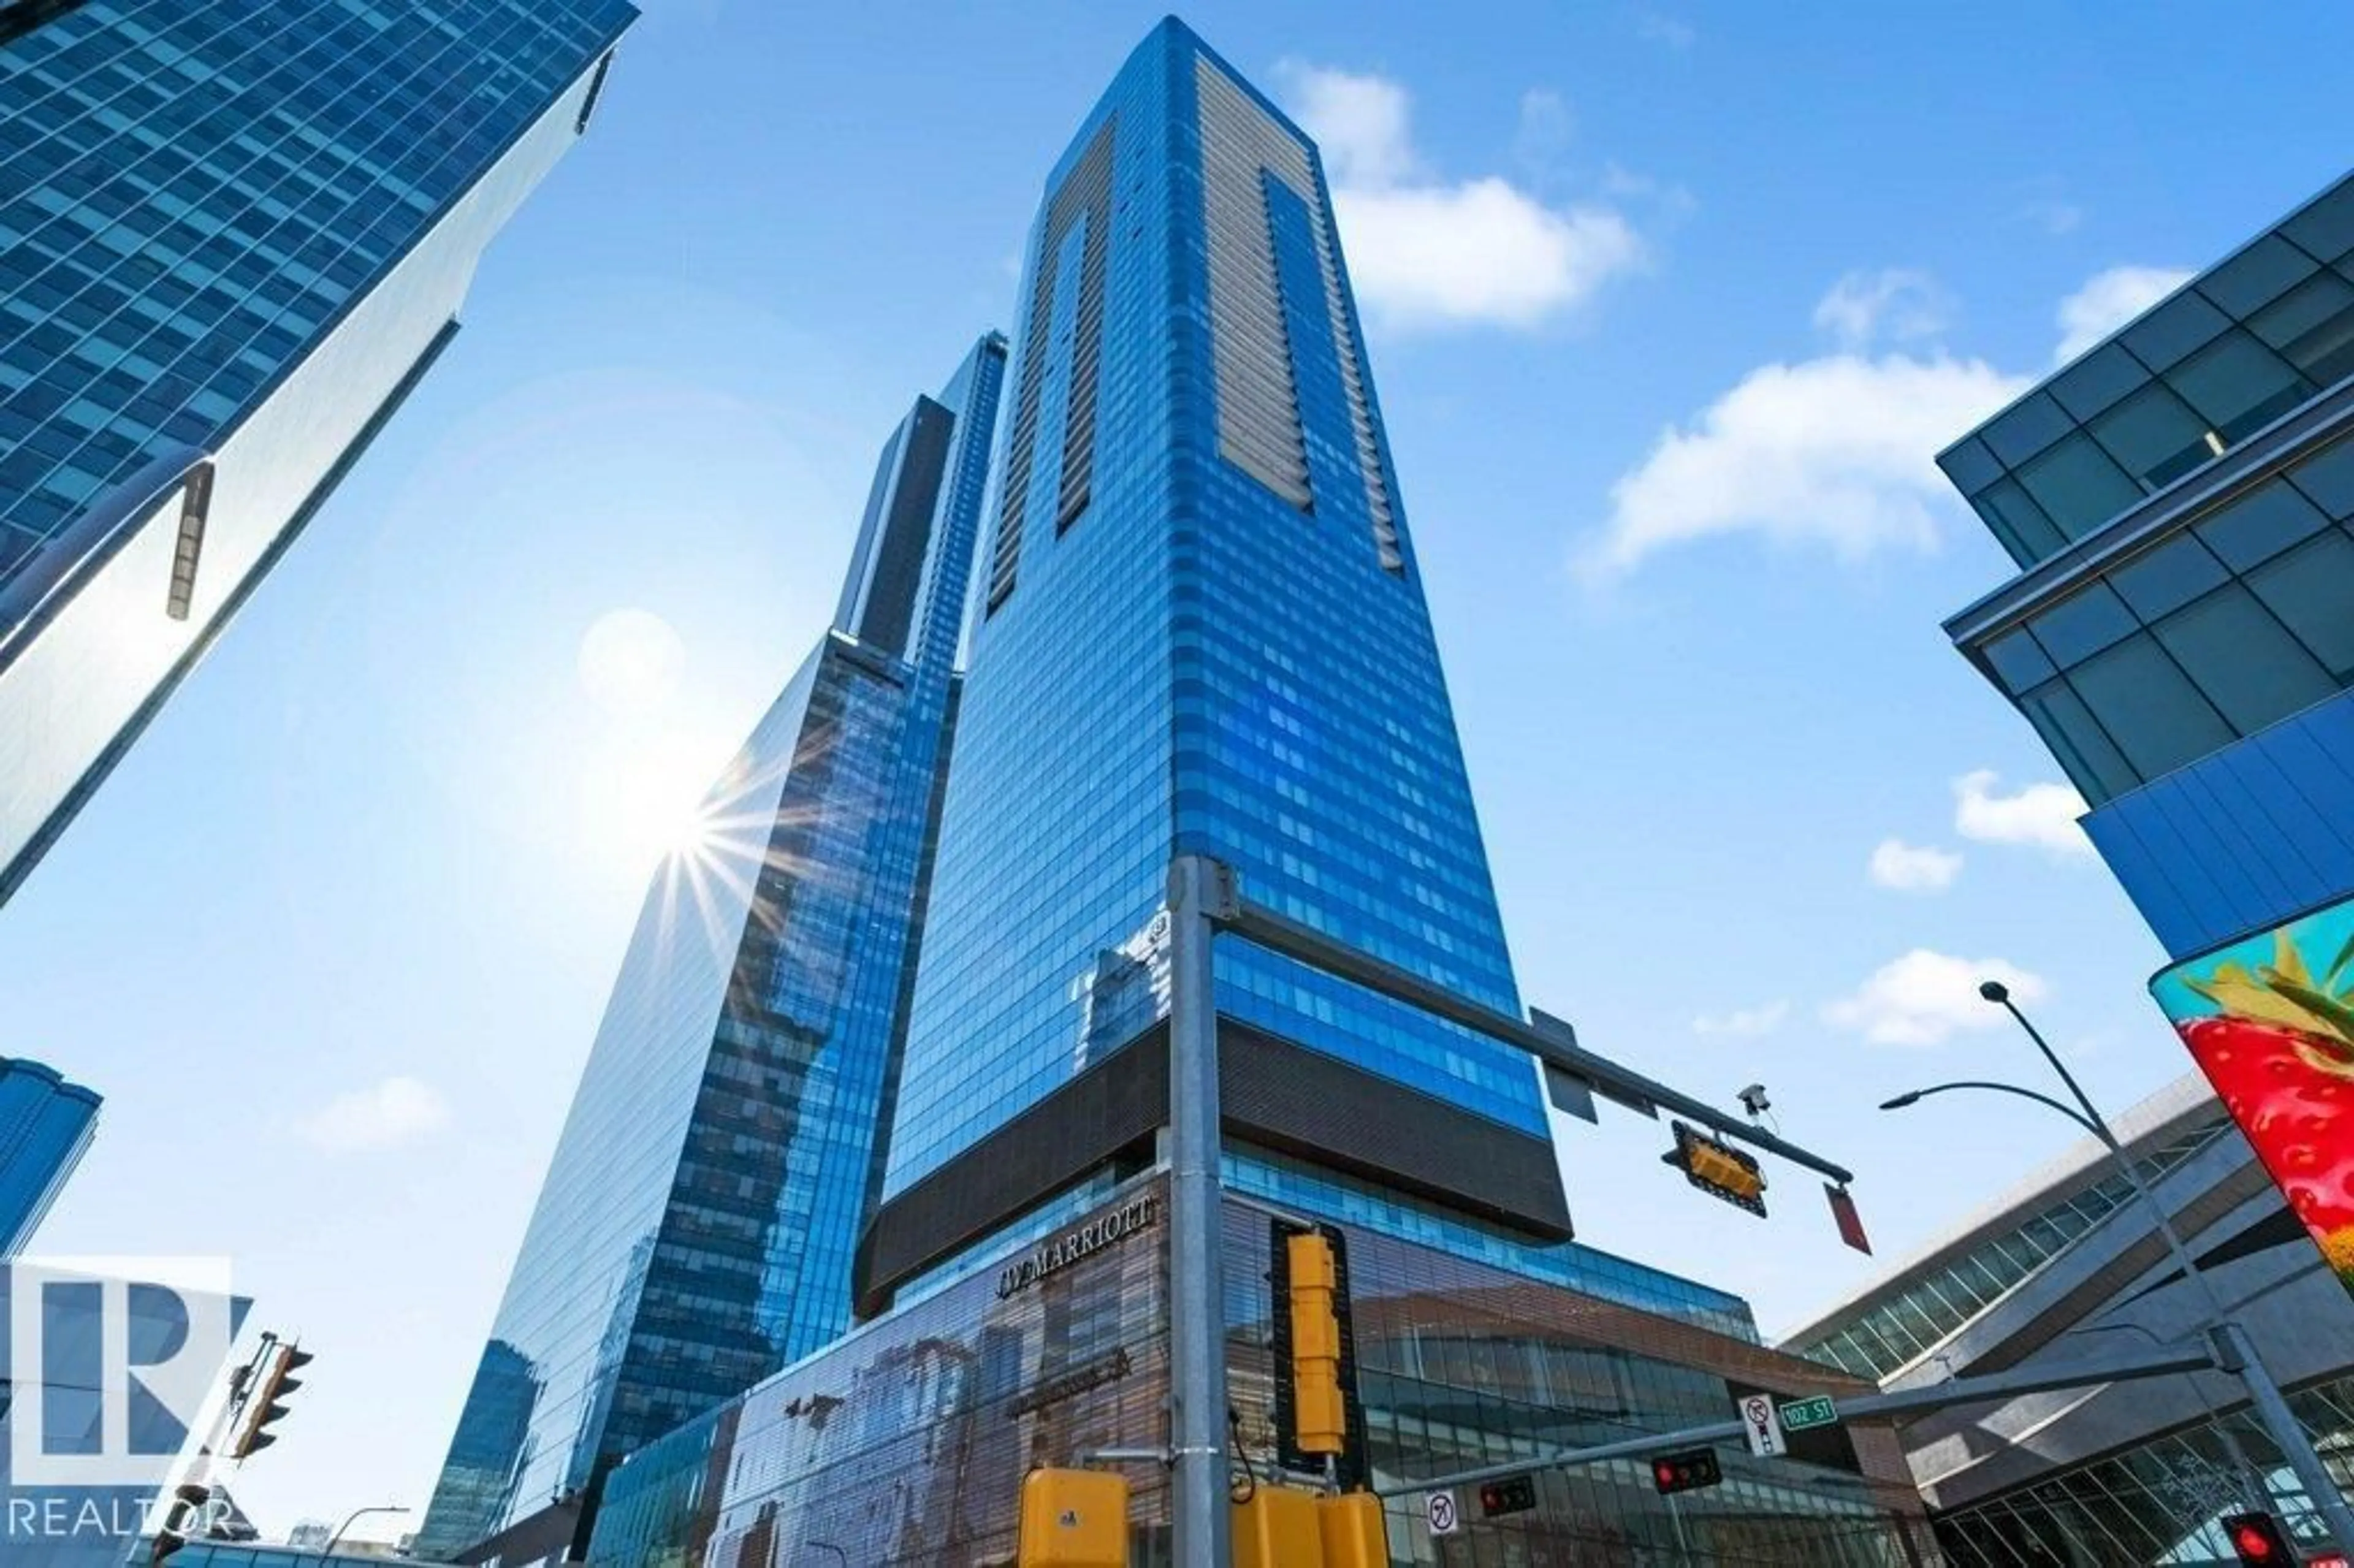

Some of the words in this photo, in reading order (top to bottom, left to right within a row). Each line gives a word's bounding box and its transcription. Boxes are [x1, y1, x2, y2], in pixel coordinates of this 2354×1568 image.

[1031, 1195, 1152, 1280] MARRIOTT
[1786, 1406, 1810, 1424] 102
[1813, 1401, 1830, 1419] ST
